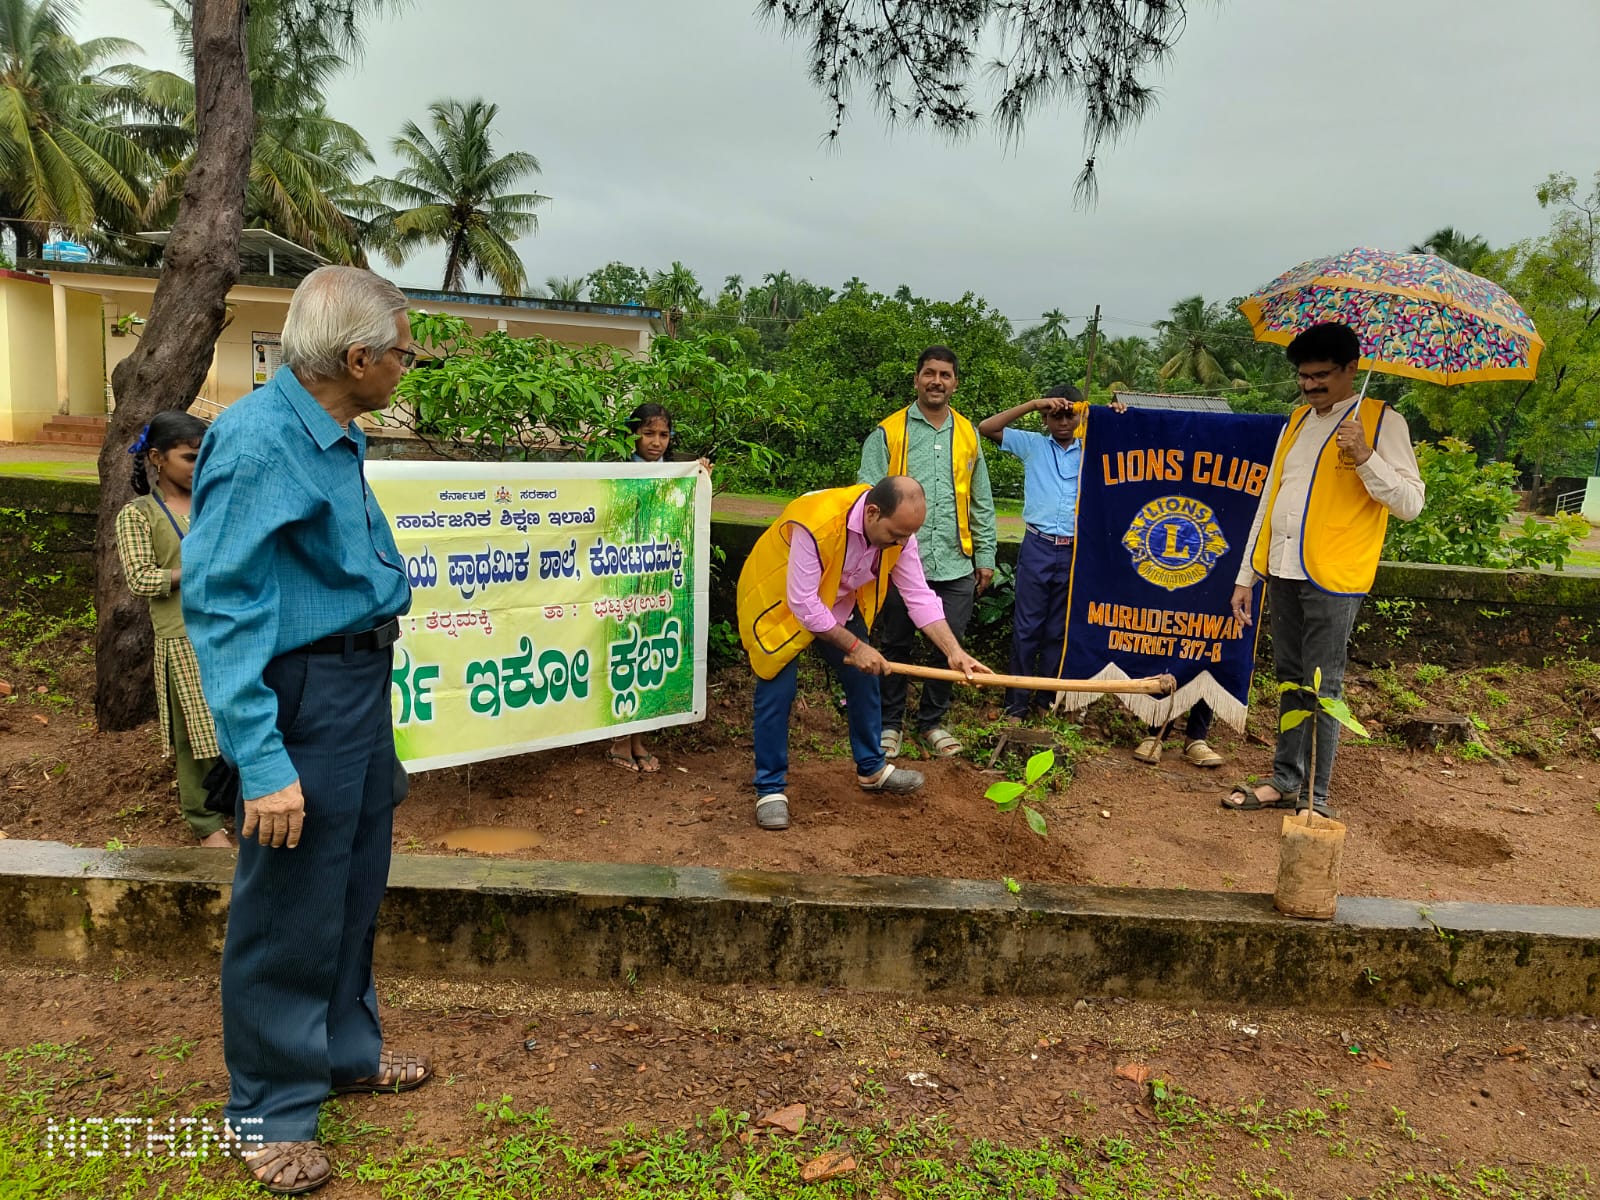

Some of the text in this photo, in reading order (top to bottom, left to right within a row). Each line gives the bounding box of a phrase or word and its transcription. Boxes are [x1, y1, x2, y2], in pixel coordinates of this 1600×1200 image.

[1102, 448, 1269, 497] LIONS CLUB
[439, 489, 558, 501] ಕರ್ನಾಟಕ ಸರಕಾರ
[1146, 497, 1209, 521] LIONS
[396, 506, 597, 533] ಸಾರ್ವಜನಿಕ ಶಿಕ್ಷಣ ಇಲಾಖೆ
[1161, 523, 1190, 558] L
[447, 541, 530, 600] ಪ್ರಾಥಮಿಕ
[1143, 562, 1204, 585] INTERNATIONAL
[1087, 600, 1244, 640] MURUDESHWAR
[1108, 630, 1178, 657] DISTRICT
[466, 635, 590, 718] ಇಕೋ
[611, 620, 679, 715] ಕ್ಲಬ್
